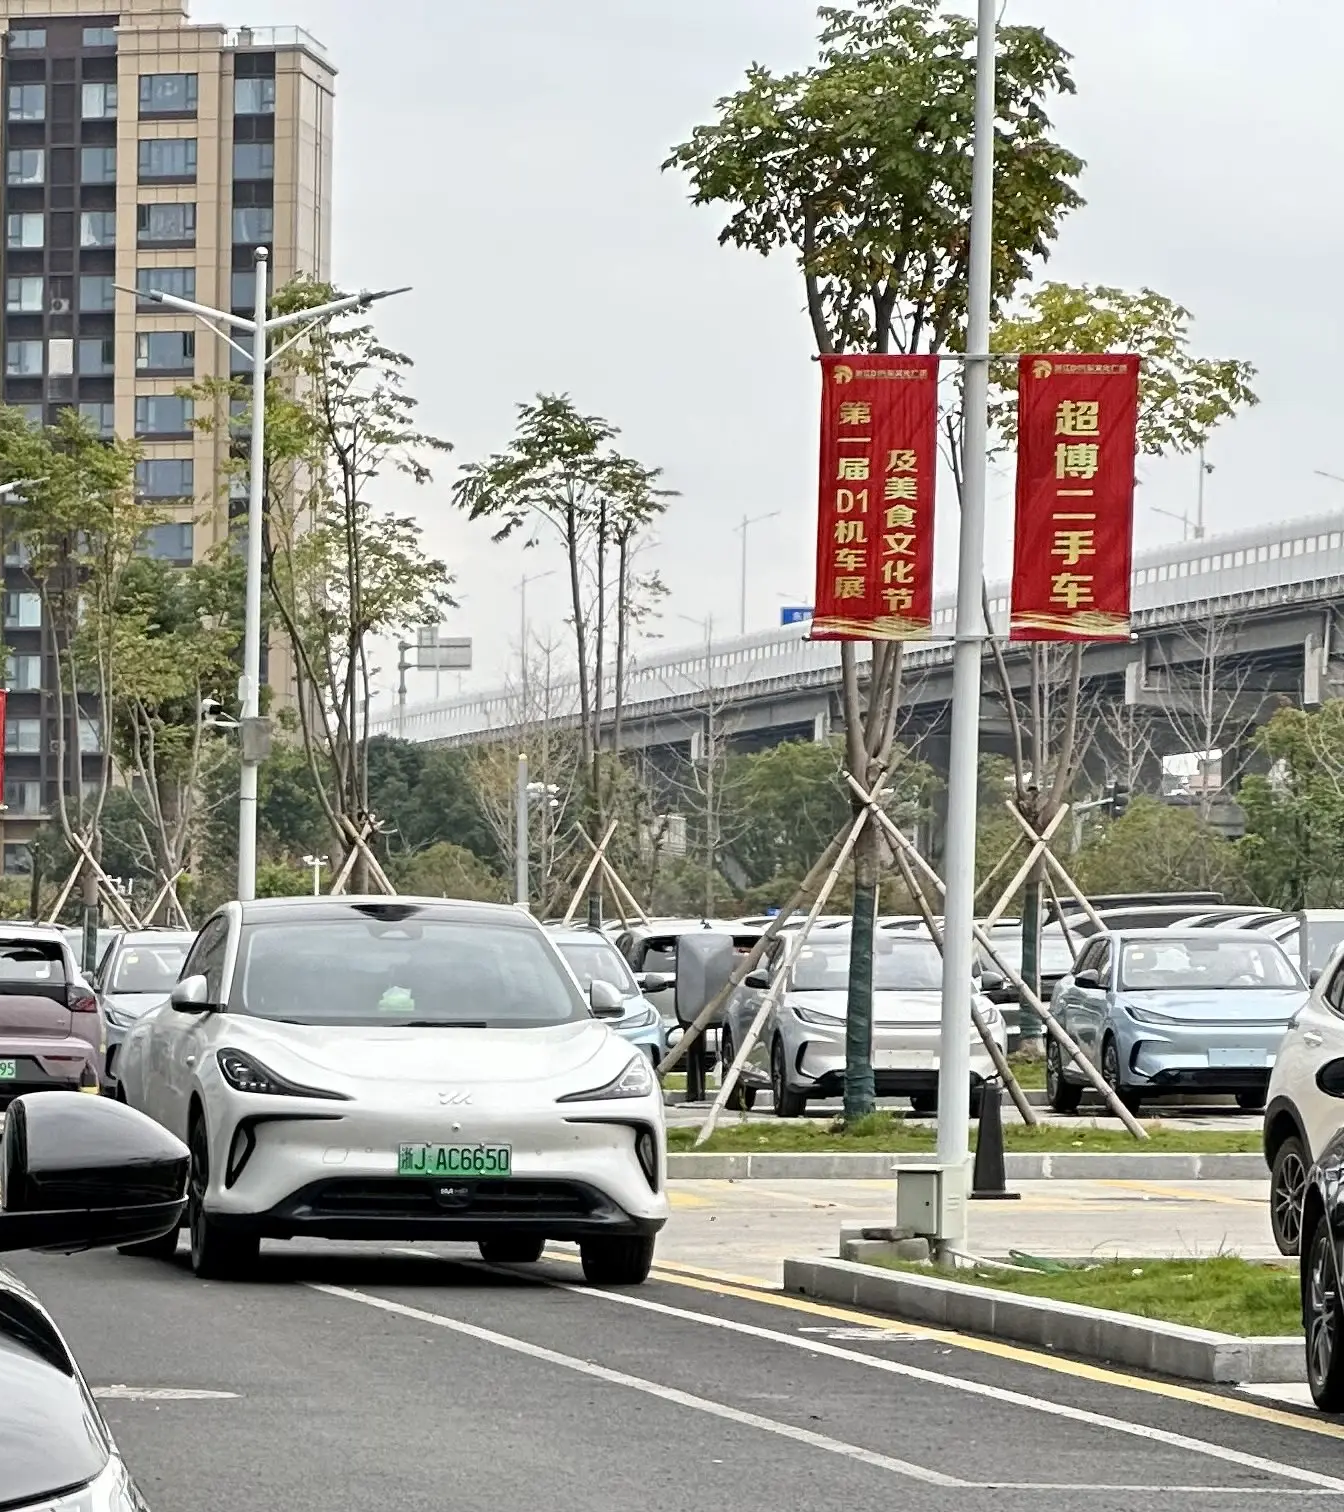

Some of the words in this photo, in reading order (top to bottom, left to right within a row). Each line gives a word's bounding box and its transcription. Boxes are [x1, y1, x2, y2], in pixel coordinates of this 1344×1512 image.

[833, 401, 873, 600] 第一届D1机车展
[881, 449, 918, 612] 及美食文化节
[1050, 400, 1100, 609] 超博二手车
[436, 1147, 509, 1171] AC6650
